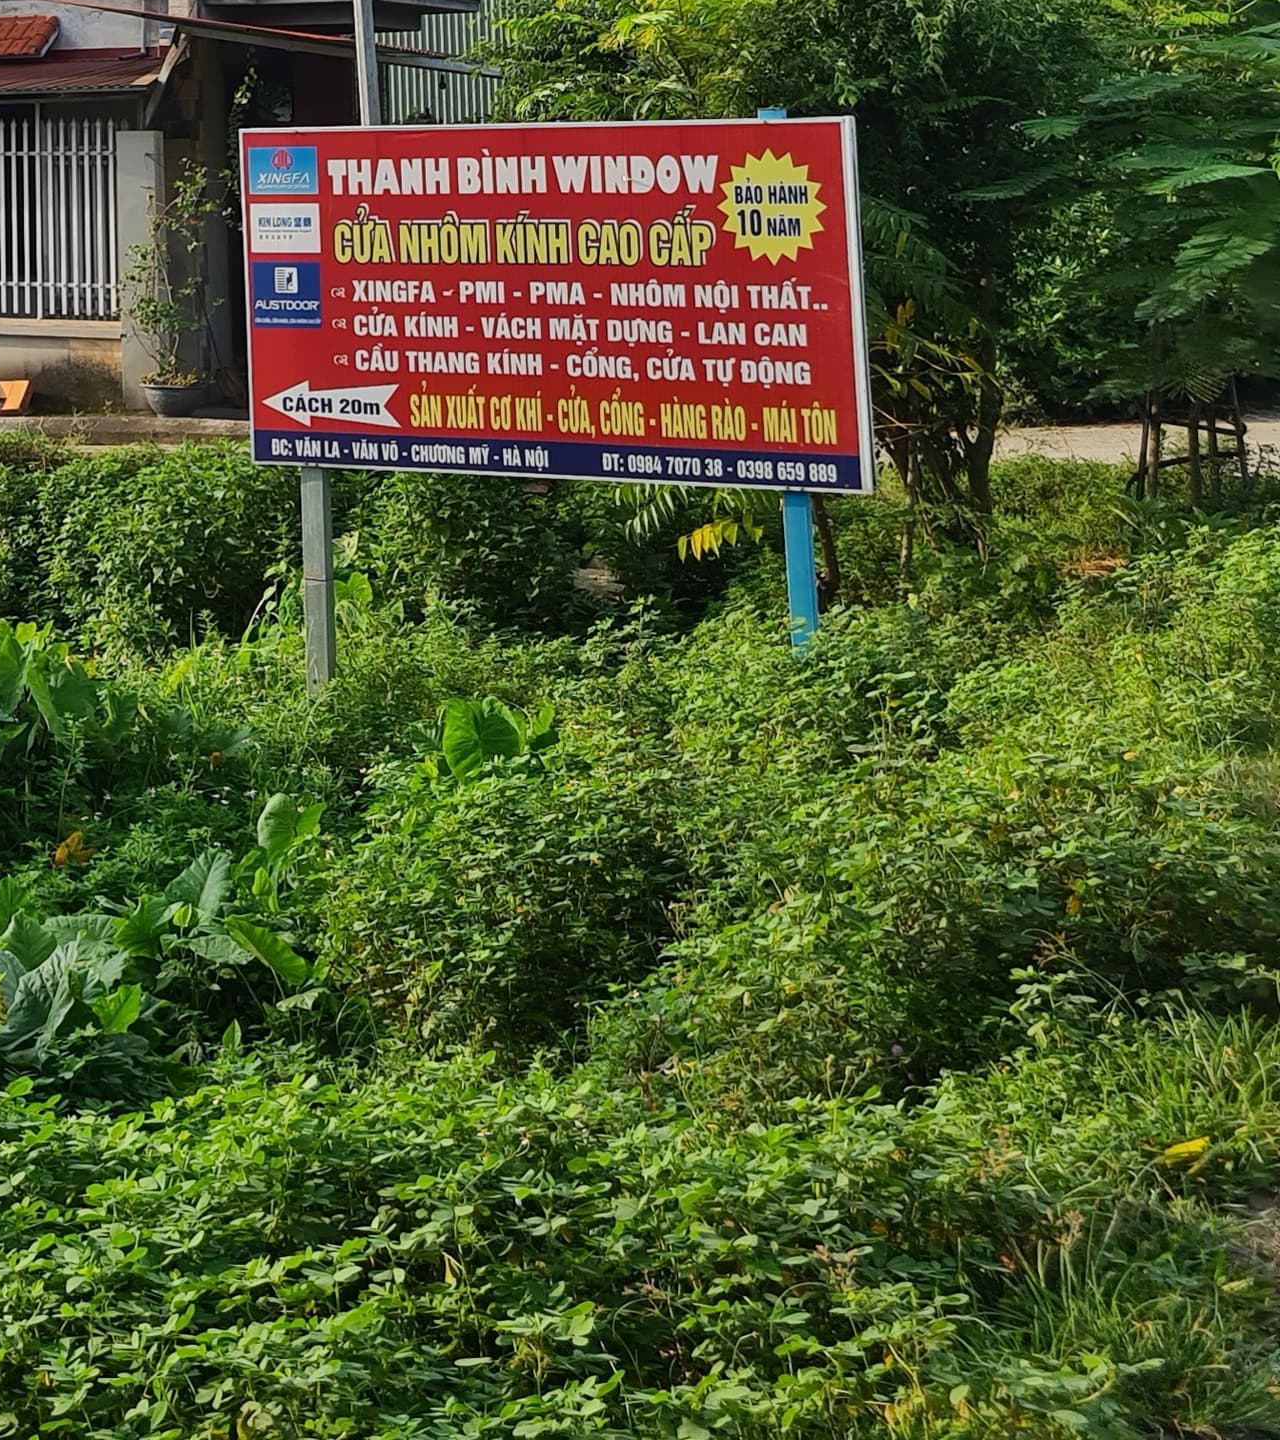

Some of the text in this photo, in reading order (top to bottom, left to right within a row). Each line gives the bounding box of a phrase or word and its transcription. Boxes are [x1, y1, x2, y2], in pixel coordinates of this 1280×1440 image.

[256, 172, 310, 184] XINGFA
[327, 148, 718, 195] THANH BÌNH WINDOW
[734, 177, 808, 205] BẢO HÀNH
[333, 203, 716, 267] CỬA NHÔM KÍNH CAO CẤP
[737, 209, 801, 237] 10 NĂM
[255, 300, 320, 310] AUSTDOOR
[352, 280, 436, 303] XINGFA
[459, 281, 505, 304] PMI
[530, 282, 585, 305] PMA
[610, 279, 686, 307] NHÔM
[694, 280, 739, 313] NỘI
[353, 306, 398, 337] CỬA
[404, 312, 458, 338] KÍNH
[481, 313, 541, 340] VÁCH
[549, 314, 599, 346] MẶT
[607, 318, 673, 347] DỰNG
[698, 322, 746, 346] LAN
[754, 323, 807, 347] CAN
[355, 343, 399, 372] CẦU
[405, 351, 480, 374] THANG
[487, 349, 543, 376] KÍNH
[646, 348, 696, 381] CỬA
[702, 358, 735, 387] TỰ
[741, 356, 811, 389] ĐỘNG
[282, 394, 381, 416] CÁCH 20m
[410, 380, 441, 429] SẢN
[446, 384, 485, 429] XUẤT
[490, 395, 512, 431] CƠ
[516, 389, 542, 432] KHÍ
[599, 387, 644, 437] CỔNG
[661, 397, 707, 440] HÀNG
[712, 398, 746, 441] RÀO
[763, 400, 797, 444] MÁI
[801, 401, 837, 445] TÔN
[295, 436, 321, 457] VĂN
[324, 440, 340, 458] LA
[352, 439, 379, 460] VĂN
[381, 440, 399, 461] VÕ
[411, 444, 465, 465] CHƯƠNG
[468, 442, 489, 465] MỸ
[503, 446, 522, 468] HÀ
[525, 446, 549, 471] NỘI
[628, 454, 662, 474] 0984
[665, 456, 701, 477] 7070
[705, 458, 723, 477] 38
[737, 459, 773, 480] 0398
[776, 462, 805, 481] 659
[809, 463, 837, 483] 889
